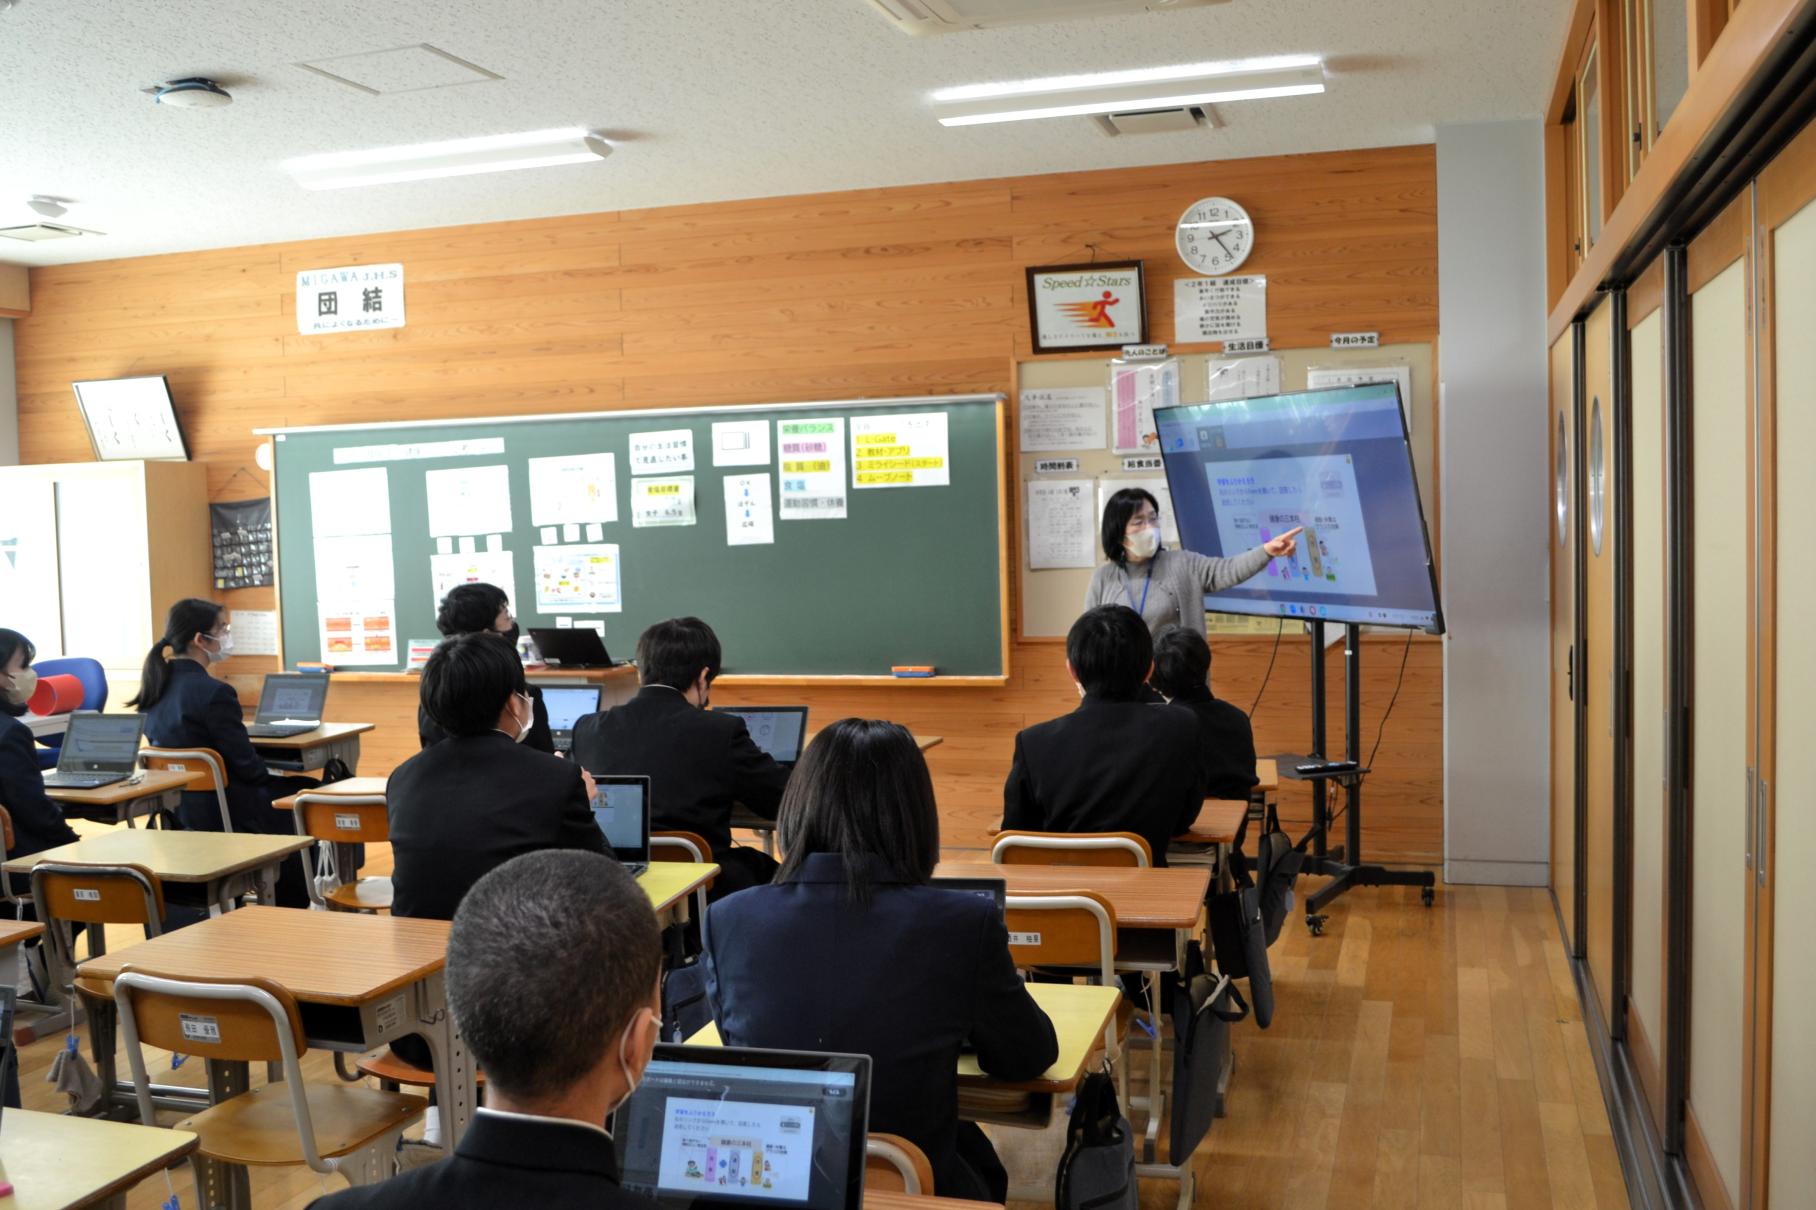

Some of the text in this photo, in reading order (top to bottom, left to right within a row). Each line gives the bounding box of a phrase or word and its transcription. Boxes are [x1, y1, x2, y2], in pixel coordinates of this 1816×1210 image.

[1198, 212, 1206, 220] 11
[1209, 208, 1219, 217] 12
[1224, 209, 1229, 218] 1
[1187, 234, 1194, 242] 9
[1236, 231, 1243, 240] 3
[1190, 246, 1198, 254] 8
[1233, 243, 1240, 252] 4
[1201, 255, 1206, 263] 7
[1212, 256, 1219, 265] 6
[1042, 275, 1132, 290] Speed Stars
[318, 286, 384, 317] 団結
[1334, 336, 1376, 346] 今月の予定
[1228, 340, 1263, 352] 生活目標
[1040, 463, 1074, 472] 時間割表
[1127, 458, 1161, 469] 給食当番
